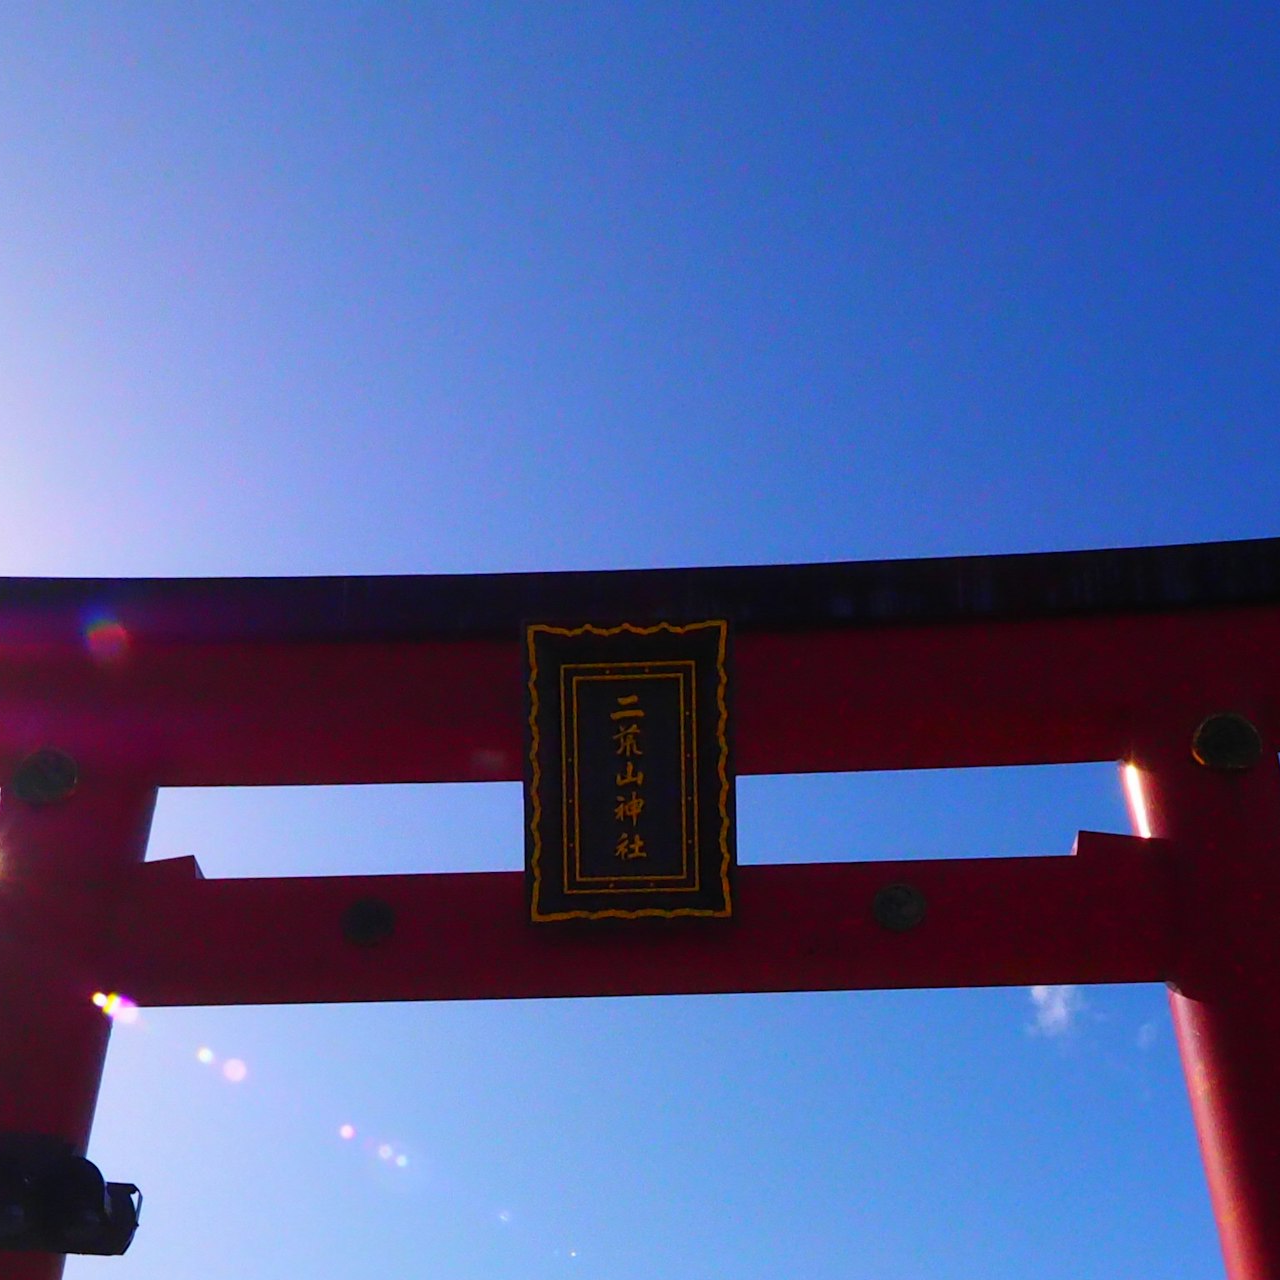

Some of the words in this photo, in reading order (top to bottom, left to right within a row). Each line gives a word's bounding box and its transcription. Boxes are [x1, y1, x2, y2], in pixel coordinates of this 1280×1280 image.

[610, 695, 647, 860] 二荒山神社
